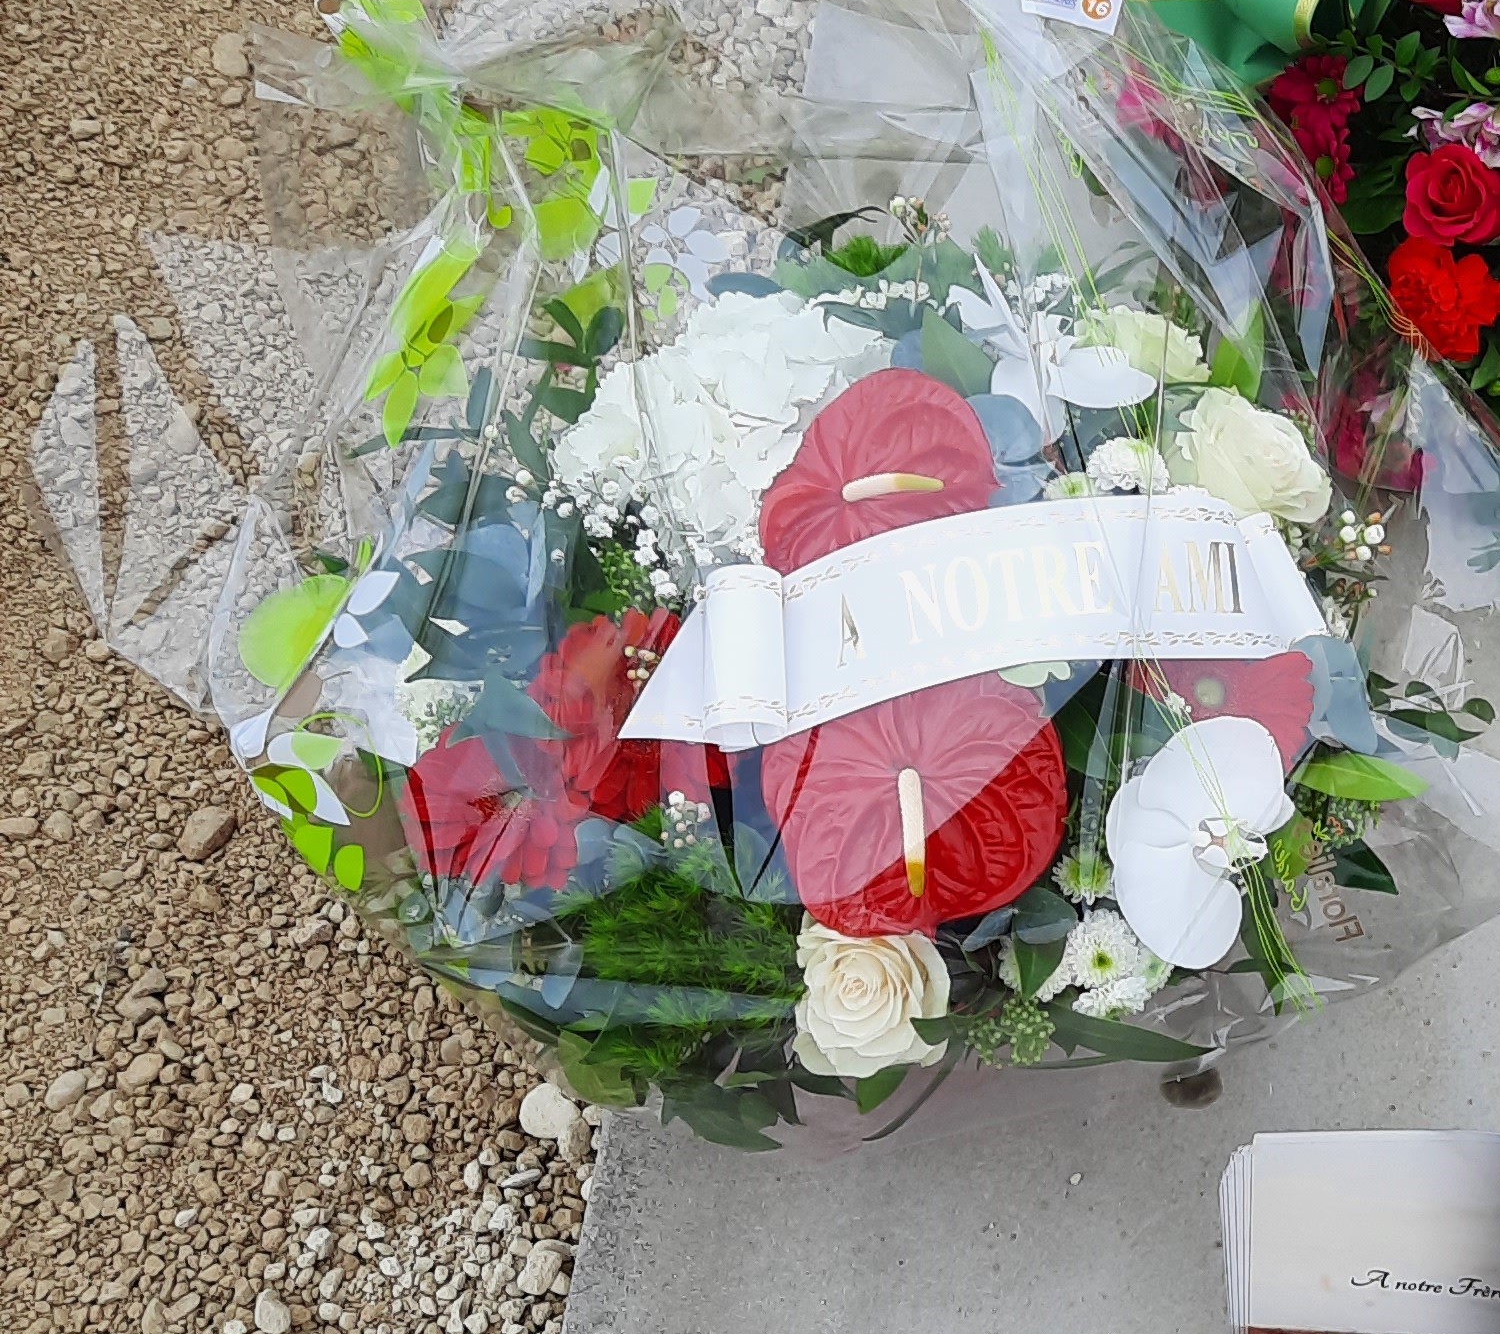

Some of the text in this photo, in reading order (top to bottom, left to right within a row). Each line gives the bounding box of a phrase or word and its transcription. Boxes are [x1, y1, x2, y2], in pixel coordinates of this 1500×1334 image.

[835, 539, 1245, 667] A NOTRE AMI
[1351, 1269, 1389, 1289] A
[1394, 1280, 1443, 1294] notre
